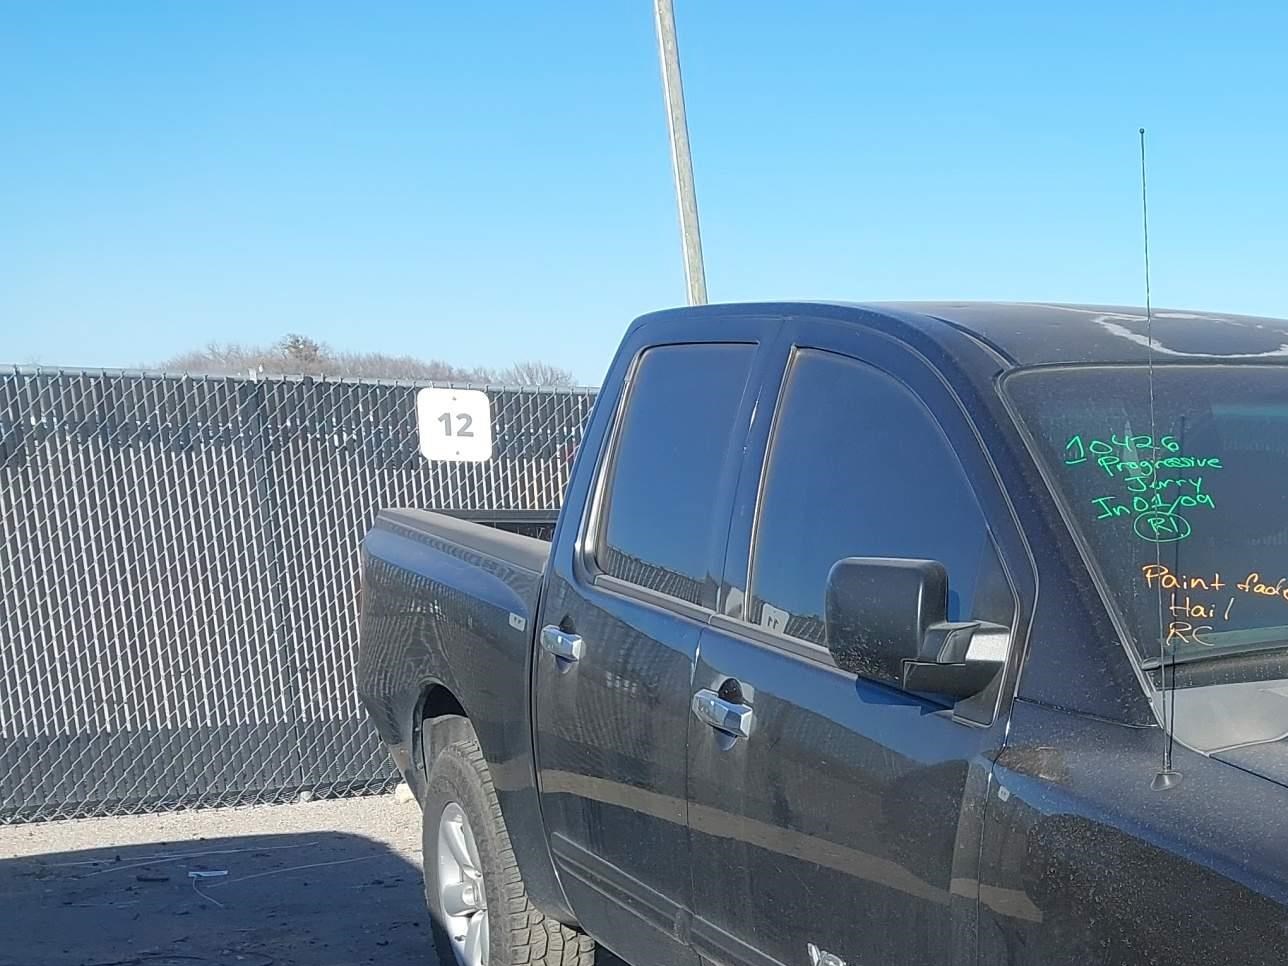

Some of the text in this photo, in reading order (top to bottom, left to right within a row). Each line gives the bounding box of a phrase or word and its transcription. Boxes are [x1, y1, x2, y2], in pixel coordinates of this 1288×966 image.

[437, 412, 475, 437] 12
[1064, 434, 1180, 464] 10426
[1097, 455, 1223, 477] Progressive
[1133, 493, 1216, 516] 01/09
[1142, 564, 1226, 591] Paint
[1169, 593, 1235, 621] Hail
